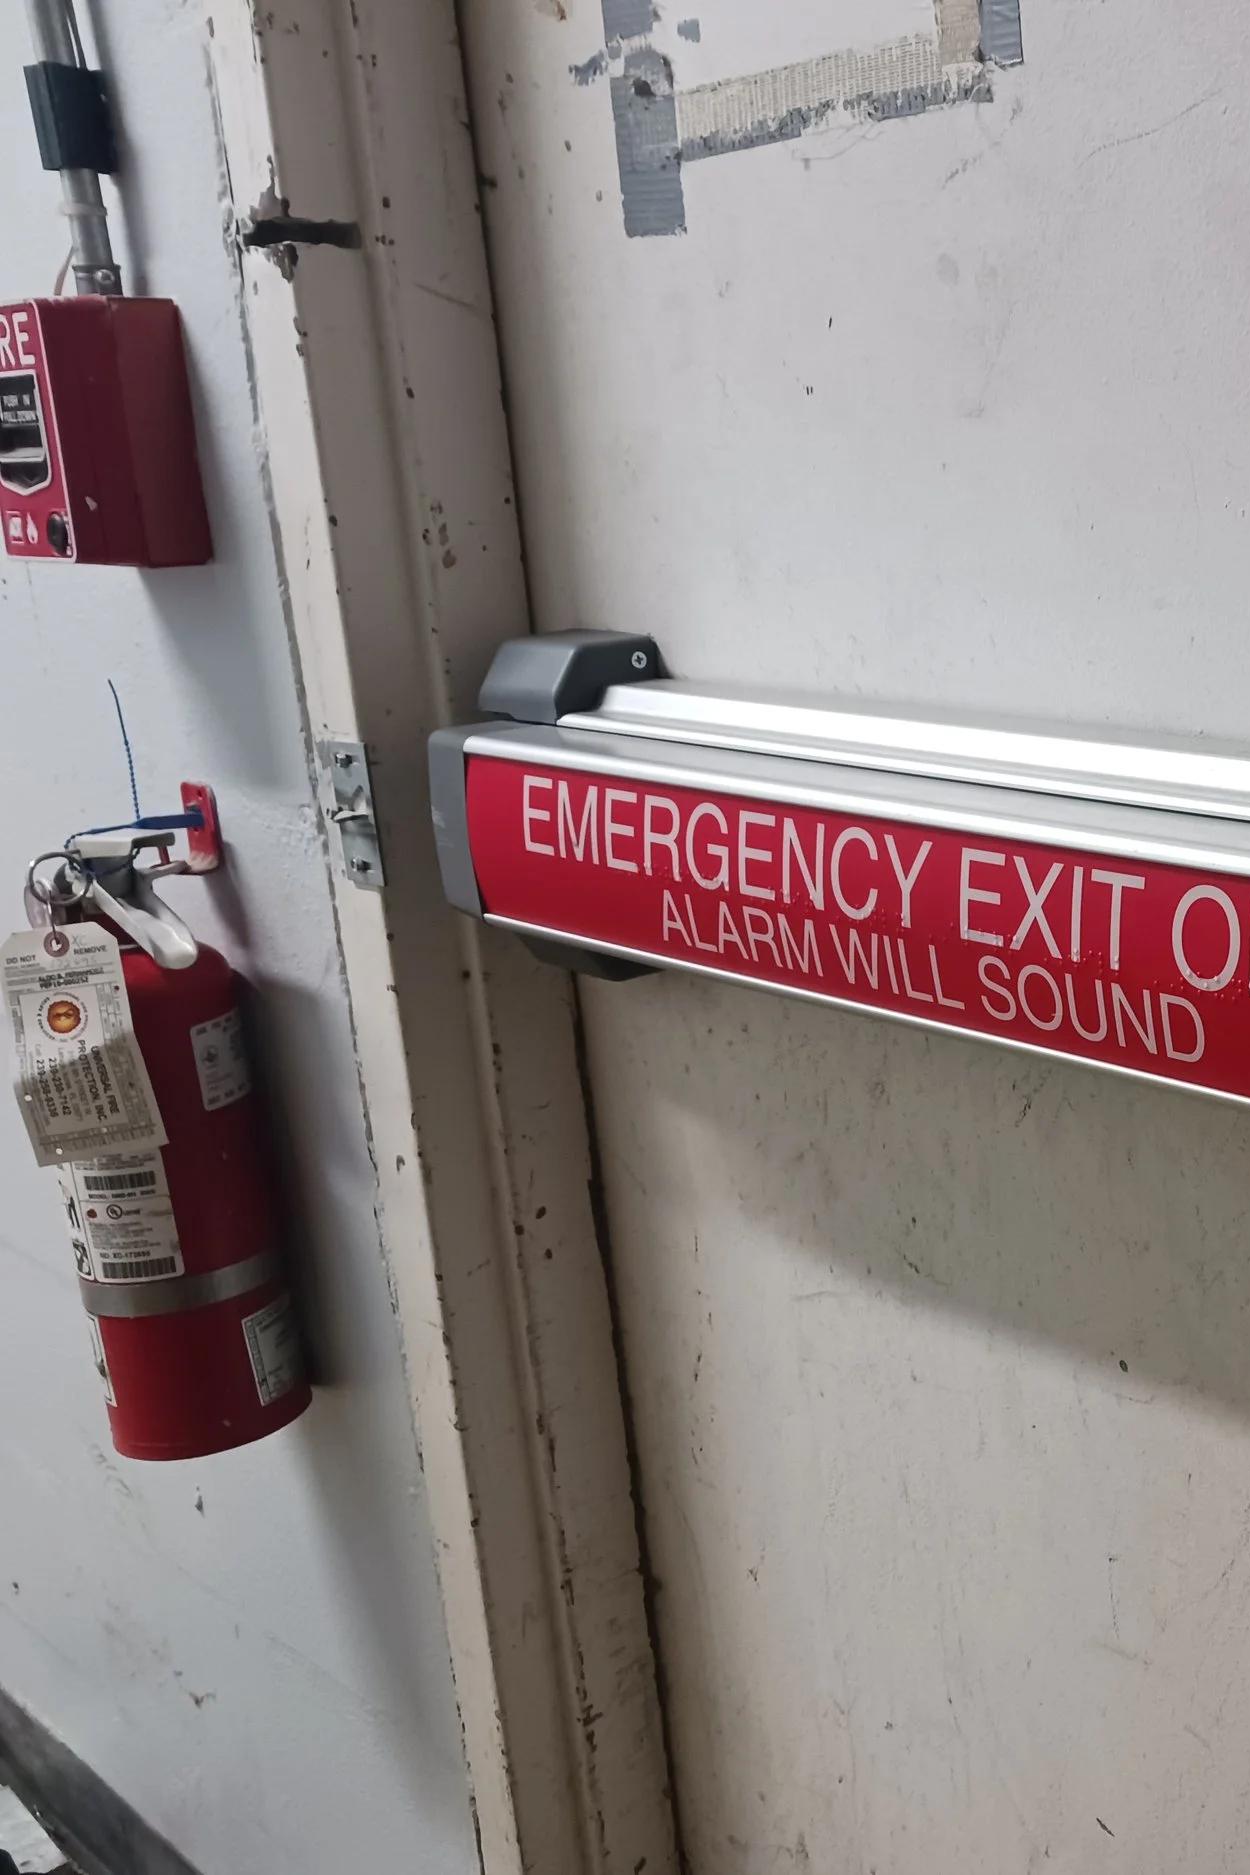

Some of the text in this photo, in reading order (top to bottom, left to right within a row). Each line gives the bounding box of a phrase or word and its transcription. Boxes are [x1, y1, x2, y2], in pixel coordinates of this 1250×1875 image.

[522, 773, 933, 929] EMERGENCY
[959, 846, 1146, 971] EXIT
[6, 945, 107, 965] DO NOT REMOVE
[662, 888, 1205, 1063] ALARM WILL SOUND
[90, 1046, 120, 1114] UNIVERSAL FIRE
